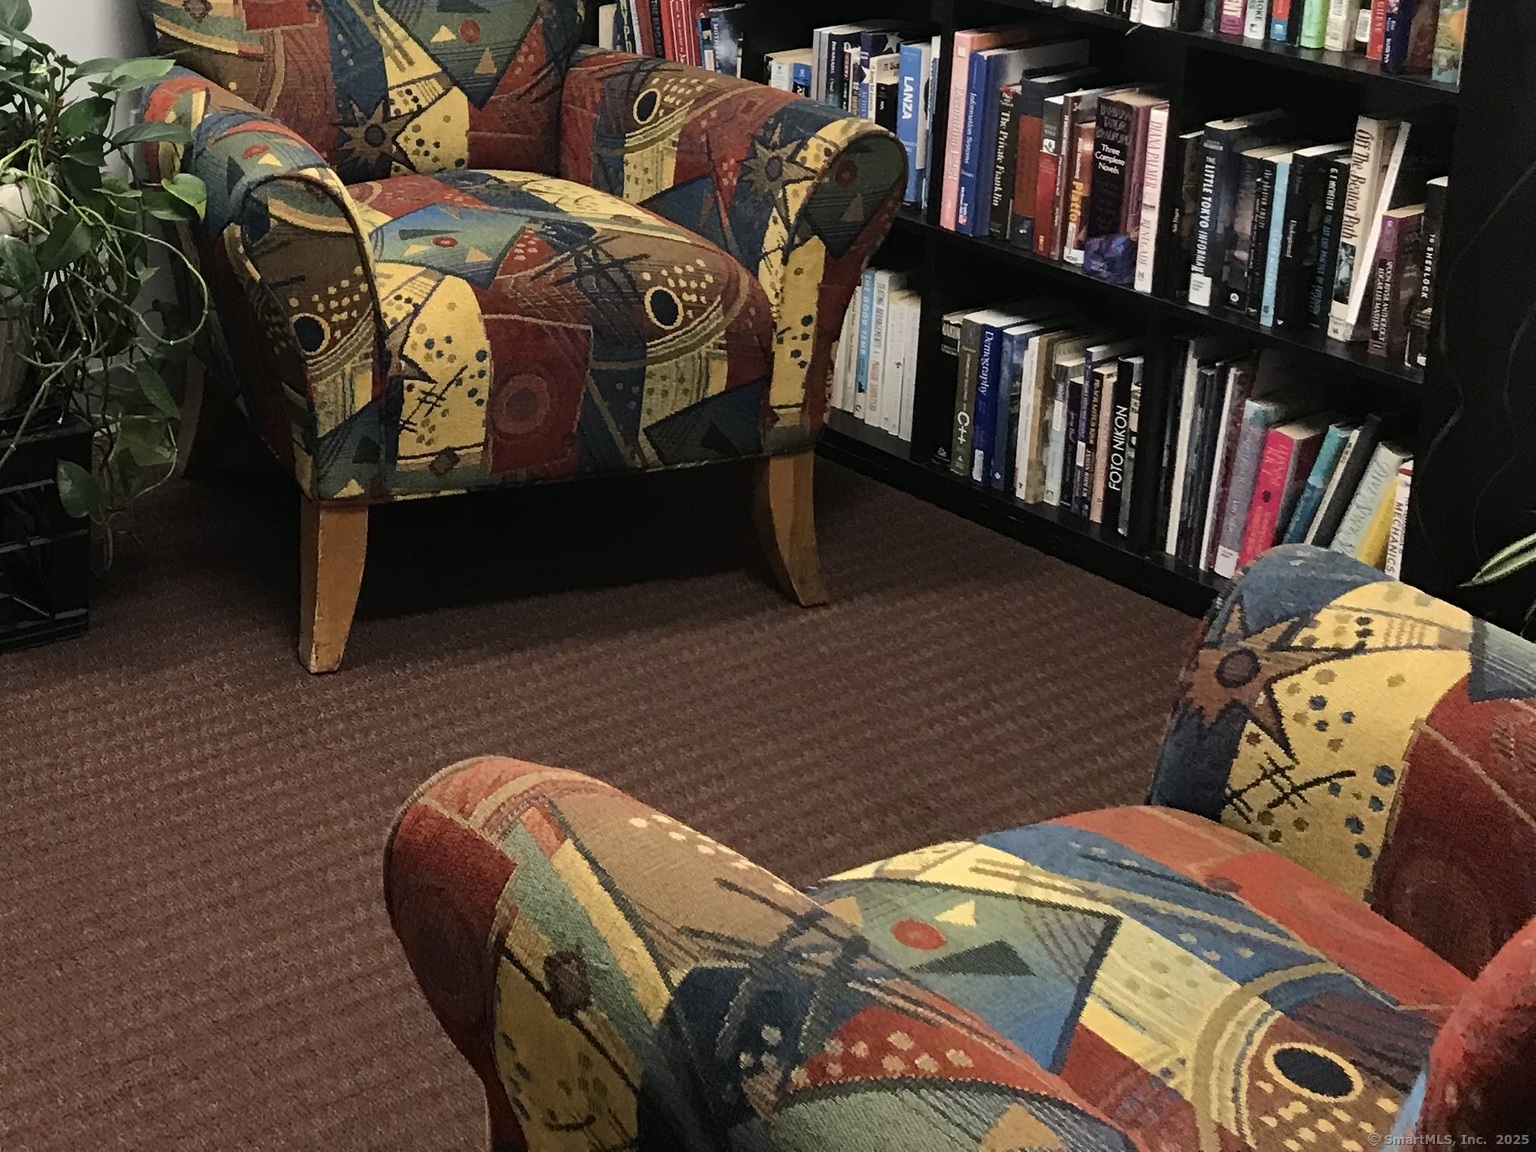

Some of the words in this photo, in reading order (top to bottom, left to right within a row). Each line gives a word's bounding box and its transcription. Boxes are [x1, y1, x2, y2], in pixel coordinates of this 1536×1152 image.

[651, 0, 659, 17] THE
[902, 76, 914, 120] LANZA
[966, 92, 976, 134] Information
[950, 86, 964, 146] Decorating
[1000, 110, 1011, 128] The
[964, 136, 972, 164] Systems
[996, 130, 1008, 163] Private
[1102, 144, 1122, 156] Three
[1148, 120, 1163, 148] DIANA
[1356, 128, 1372, 150] Off
[947, 149, 959, 180] 1-2-3
[1094, 152, 1126, 167] Complete
[1098, 162, 1120, 175] Novels
[1143, 148, 1159, 188] PALMER
[1352, 151, 1368, 170] The
[992, 165, 1004, 206] Franklin
[1204, 164, 1216, 192] LITTLE
[1346, 174, 1366, 211] Beaten
[1068, 179, 1084, 224] Platfo
[1198, 195, 1214, 228] TOKYO
[1137, 218, 1152, 266] RENEGADE
[1286, 220, 1297, 259] Underground
[1342, 214, 1360, 240] Path
[1429, 234, 1436, 244] TO
[864, 274, 872, 293] THE
[1420, 244, 1434, 299] SHERLOCK
[878, 282, 886, 305] SEATING
[1383, 282, 1392, 301] RIVER
[861, 296, 870, 325] GOOD
[1371, 299, 1382, 332] MASTERS
[1378, 302, 1390, 342] ANTHOLOGY
[873, 306, 884, 350] ARRANGEMENTS
[978, 330, 994, 396] Demography
[957, 411, 970, 444] C++
[1114, 405, 1128, 453] NIKON
[1108, 455, 1124, 491] FOTO
[1385, 502, 1404, 573] MECHANICS
